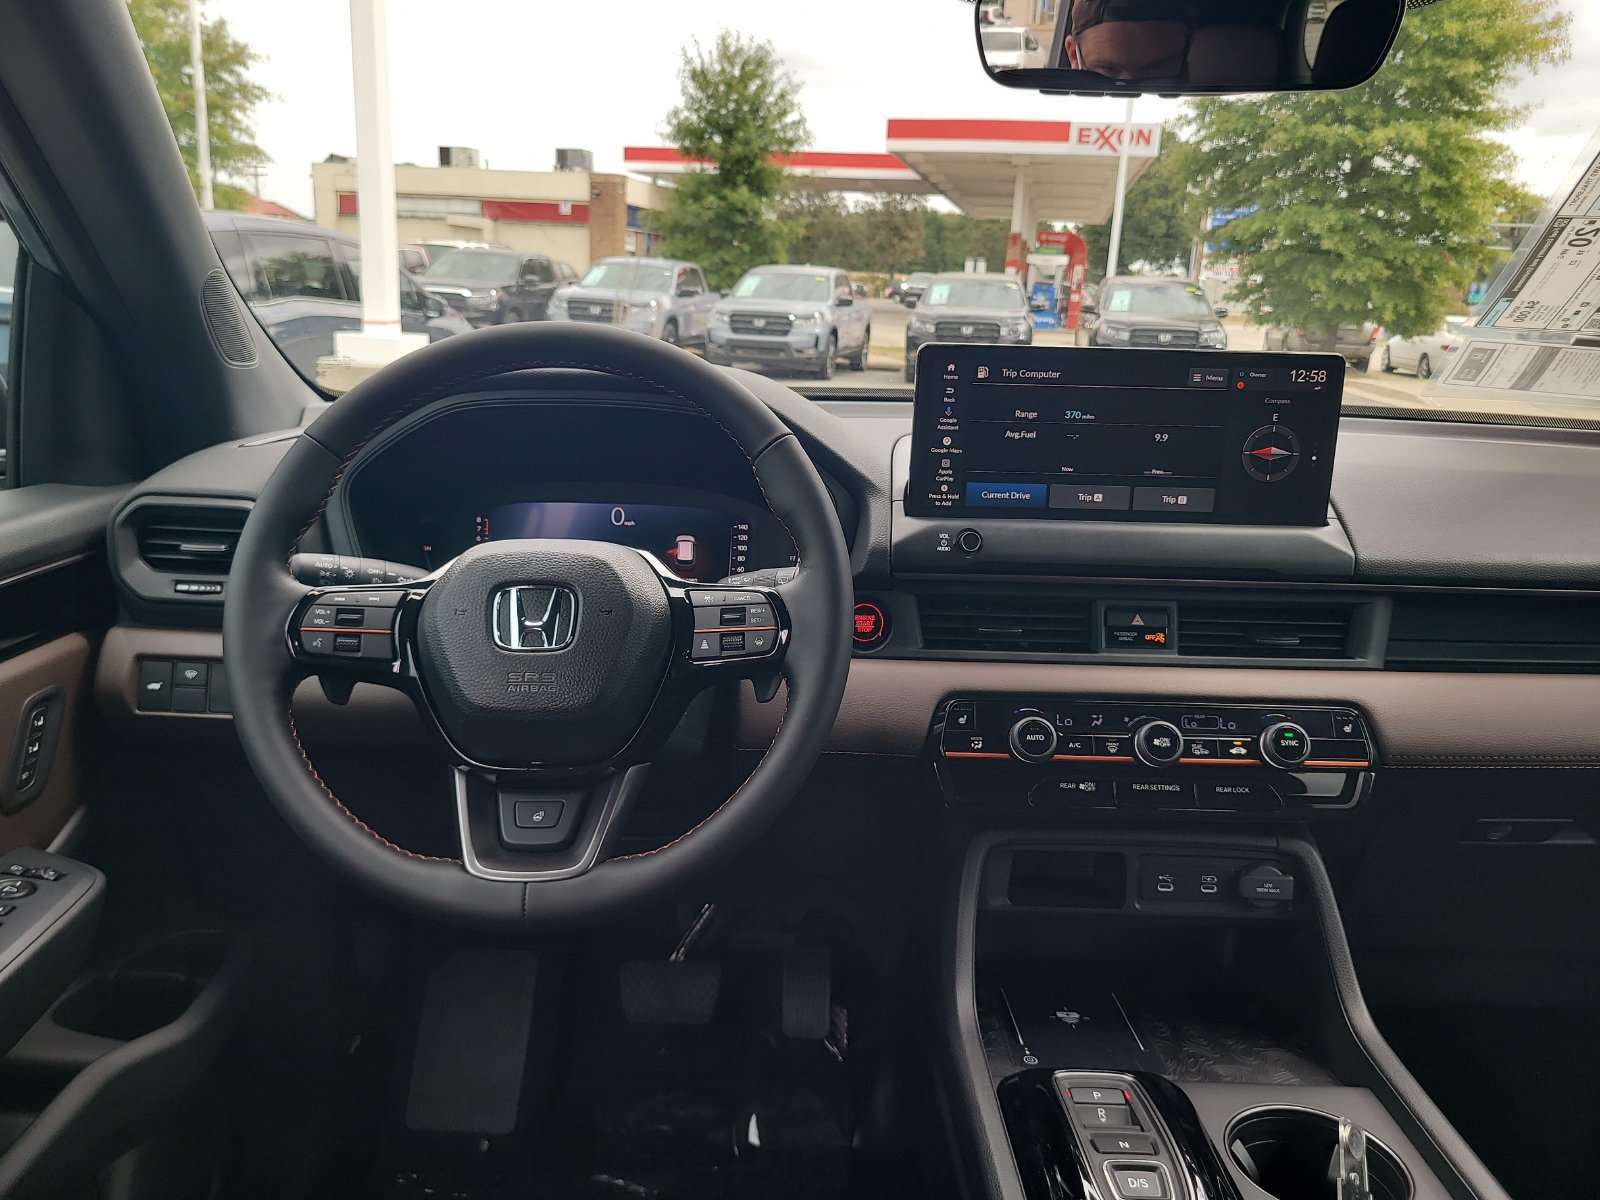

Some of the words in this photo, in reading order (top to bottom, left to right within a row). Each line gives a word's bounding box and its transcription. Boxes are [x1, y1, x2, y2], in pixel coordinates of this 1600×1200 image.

[1077, 125, 1152, 152] EXXON
[1002, 369, 1017, 378] Trip
[1019, 369, 1061, 379] Computer
[1205, 374, 1223, 382] Menu
[1289, 370, 1327, 382] 12:58
[1015, 410, 1038, 419] Range
[1064, 411, 1082, 419] 370
[1154, 433, 1169, 442] 9.9
[981, 491, 1009, 500] Current
[1011, 492, 1031, 500] Drive
[1077, 493, 1092, 502] Trip
[1162, 496, 1176, 504] Trip
[611, 507, 625, 526] 0
[507, 672, 556, 682] SRS
[507, 684, 556, 693] AIRBAG
[1280, 739, 1299, 747] SYNC
[1097, 1108, 1106, 1119] R
[1128, 1177, 1149, 1189] D/S
